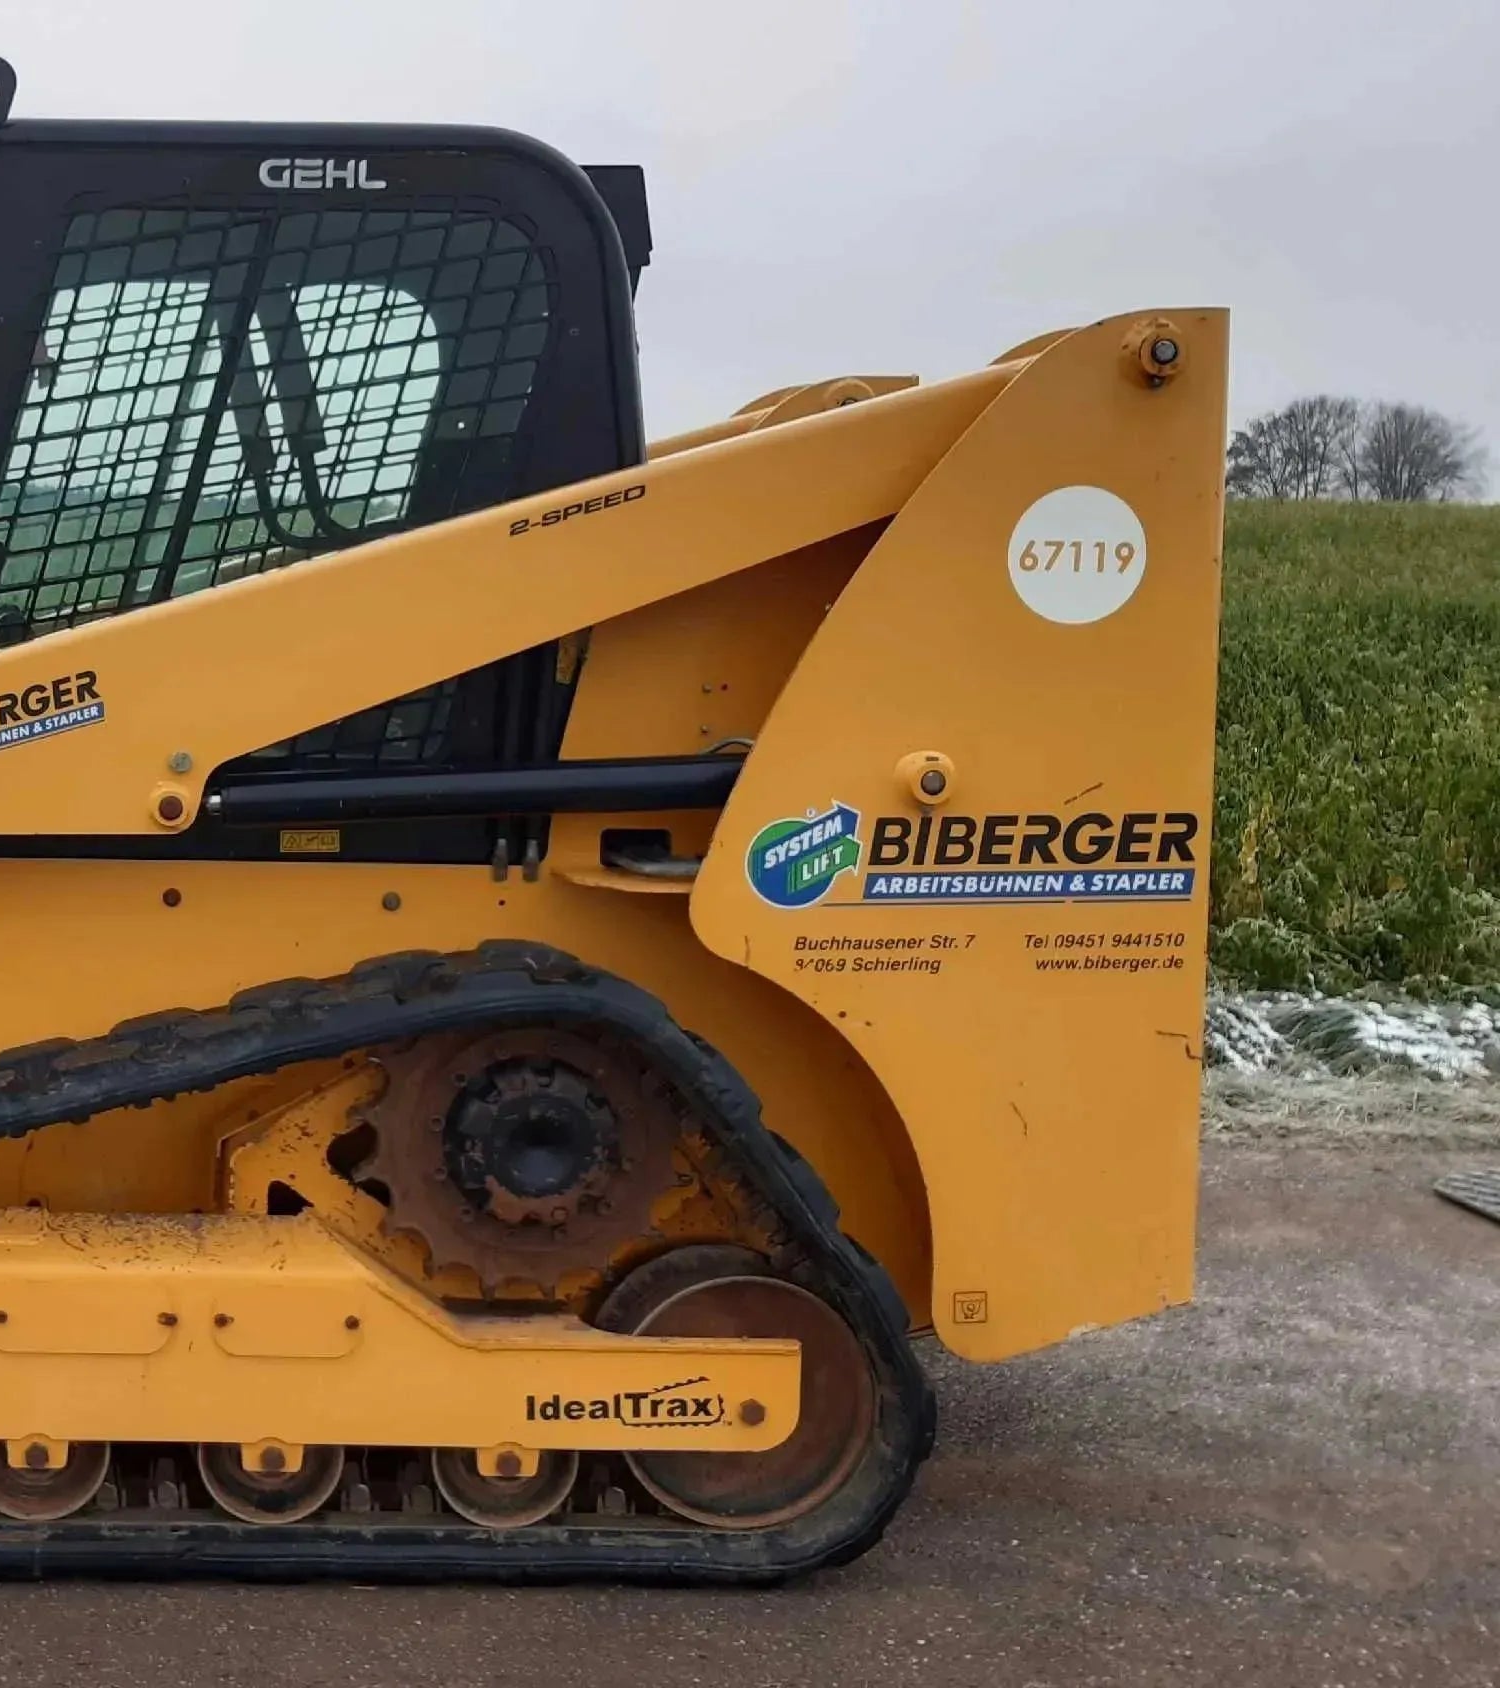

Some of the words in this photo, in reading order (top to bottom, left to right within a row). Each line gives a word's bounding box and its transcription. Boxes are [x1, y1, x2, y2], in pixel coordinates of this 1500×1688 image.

[258, 157, 387, 189] GEHL
[509, 484, 647, 537] 2-SPEED
[1019, 539, 1136, 574] 67119
[32, 721, 43, 735] &
[45, 705, 100, 731] STAPLER
[763, 814, 843, 870] SYSTEM
[867, 812, 1198, 866] BIBERGER
[802, 845, 844, 881] LIFT
[870, 874, 1064, 894] ARBEITSBÜHNEN
[1069, 873, 1086, 892] &
[1090, 872, 1185, 892] STAPLER
[794, 936, 925, 951] Buchhausener
[929, 934, 959, 949] Str.
[964, 934, 977, 949] 7
[1024, 933, 1049, 949] Tel
[1054, 933, 1106, 949] 09451
[1111, 932, 1186, 948] 9441510
[851, 956, 942, 975] Schierling
[1035, 954, 1185, 973] www.biberger.de
[525, 1391, 714, 1421] IdealTrax
